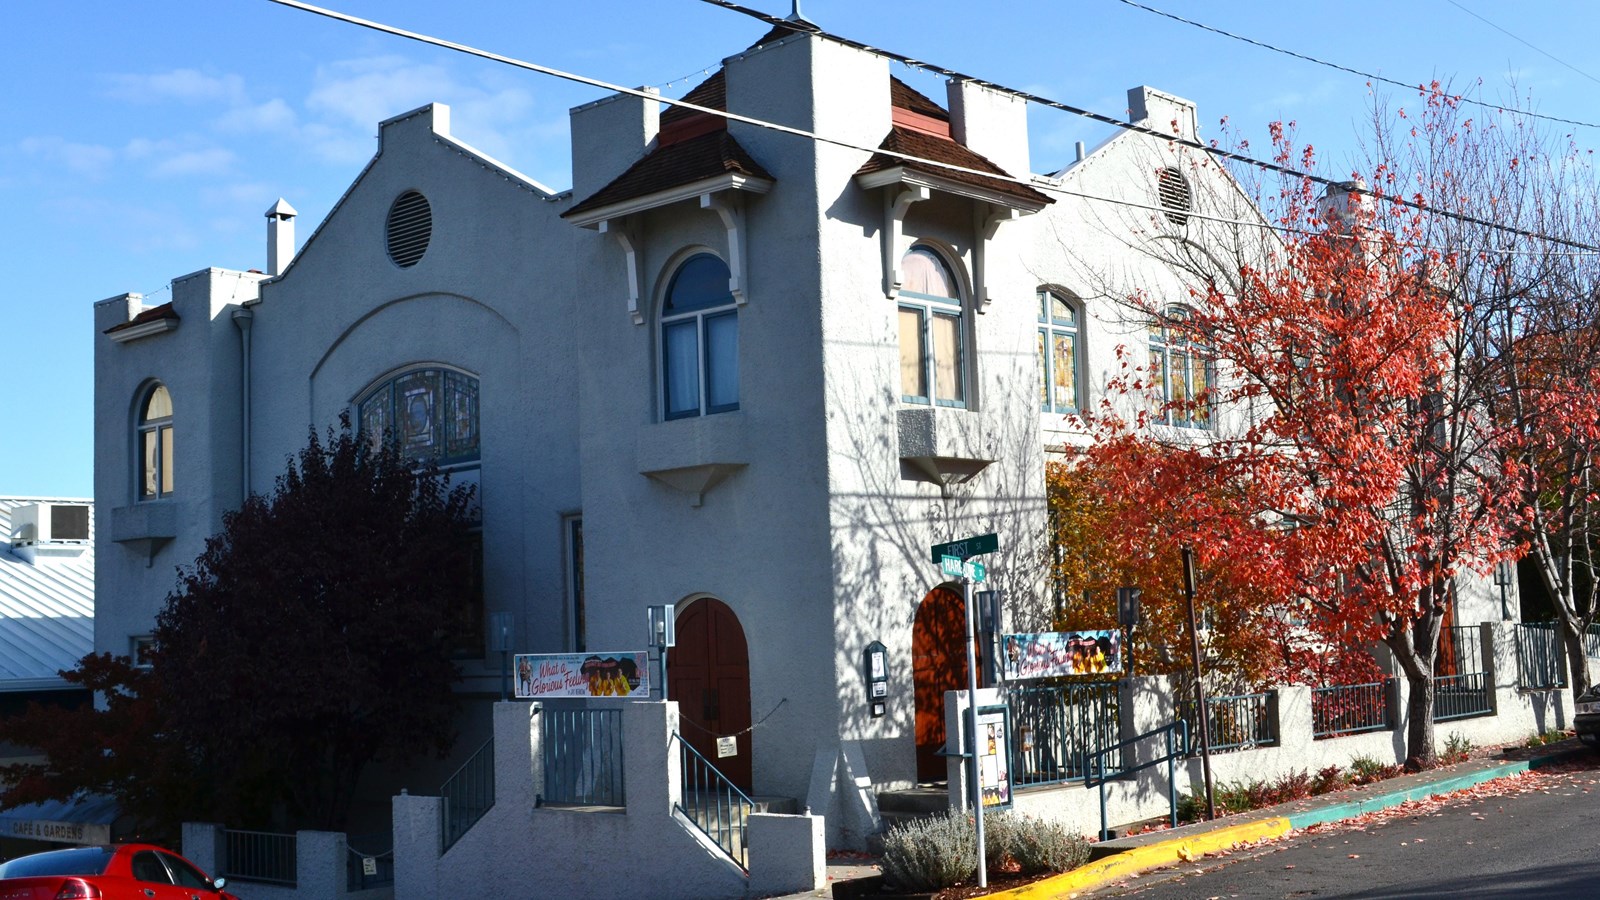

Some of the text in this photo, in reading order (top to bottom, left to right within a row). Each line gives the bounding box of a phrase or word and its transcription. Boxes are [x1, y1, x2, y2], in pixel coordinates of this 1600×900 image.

[948, 542, 969, 557] FIRST
[539, 660, 567, 679] What a
[531, 670, 590, 695] Glorious Feeling
[36, 824, 41, 836] &
[43, 825, 83, 840] GARDENS
